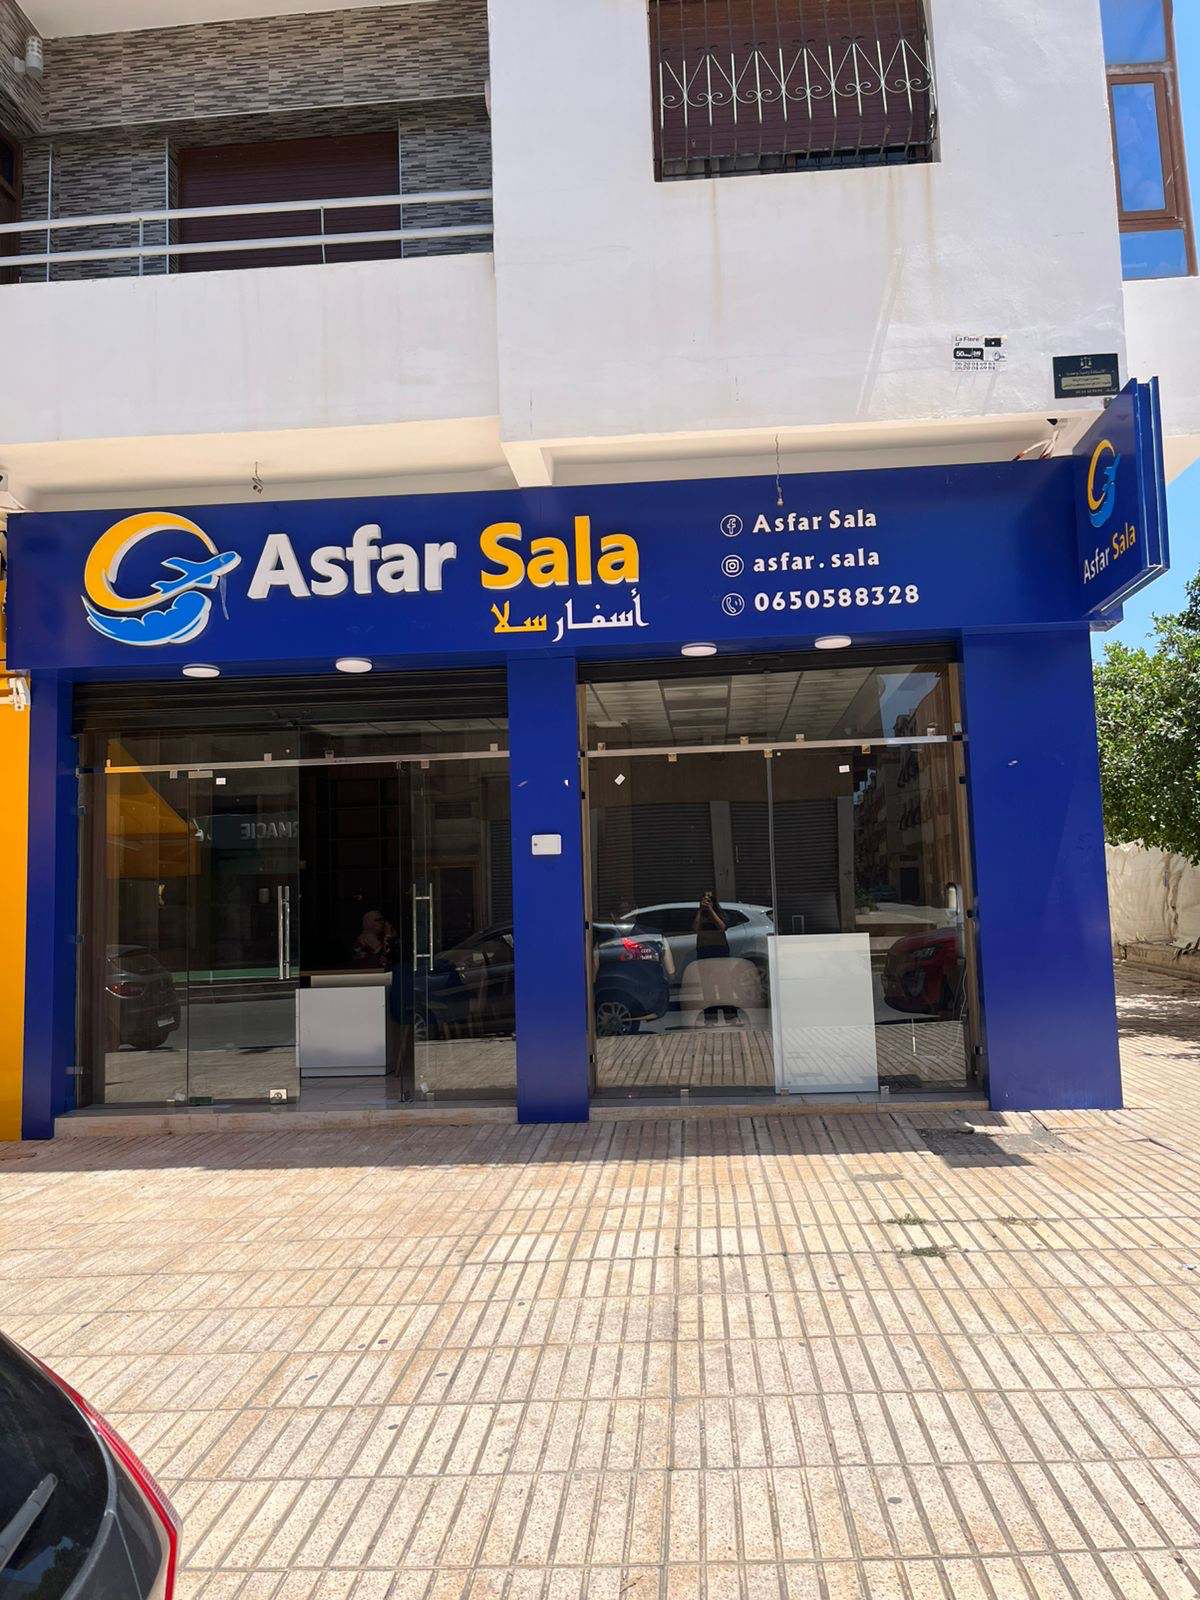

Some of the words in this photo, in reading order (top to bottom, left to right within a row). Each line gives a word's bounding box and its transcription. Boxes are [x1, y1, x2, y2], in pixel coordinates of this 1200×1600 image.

[752, 513, 822, 533] Asfar
[829, 509, 877, 529] Sala
[247, 523, 457, 599] Asfar
[479, 515, 640, 590] Sala
[1083, 547, 1110, 585] Asfar
[1112, 521, 1136, 560] Sala
[490, 600, 547, 634] سلا
[552, 587, 650, 643] أسفار
[754, 584, 920, 612] 0650588328
